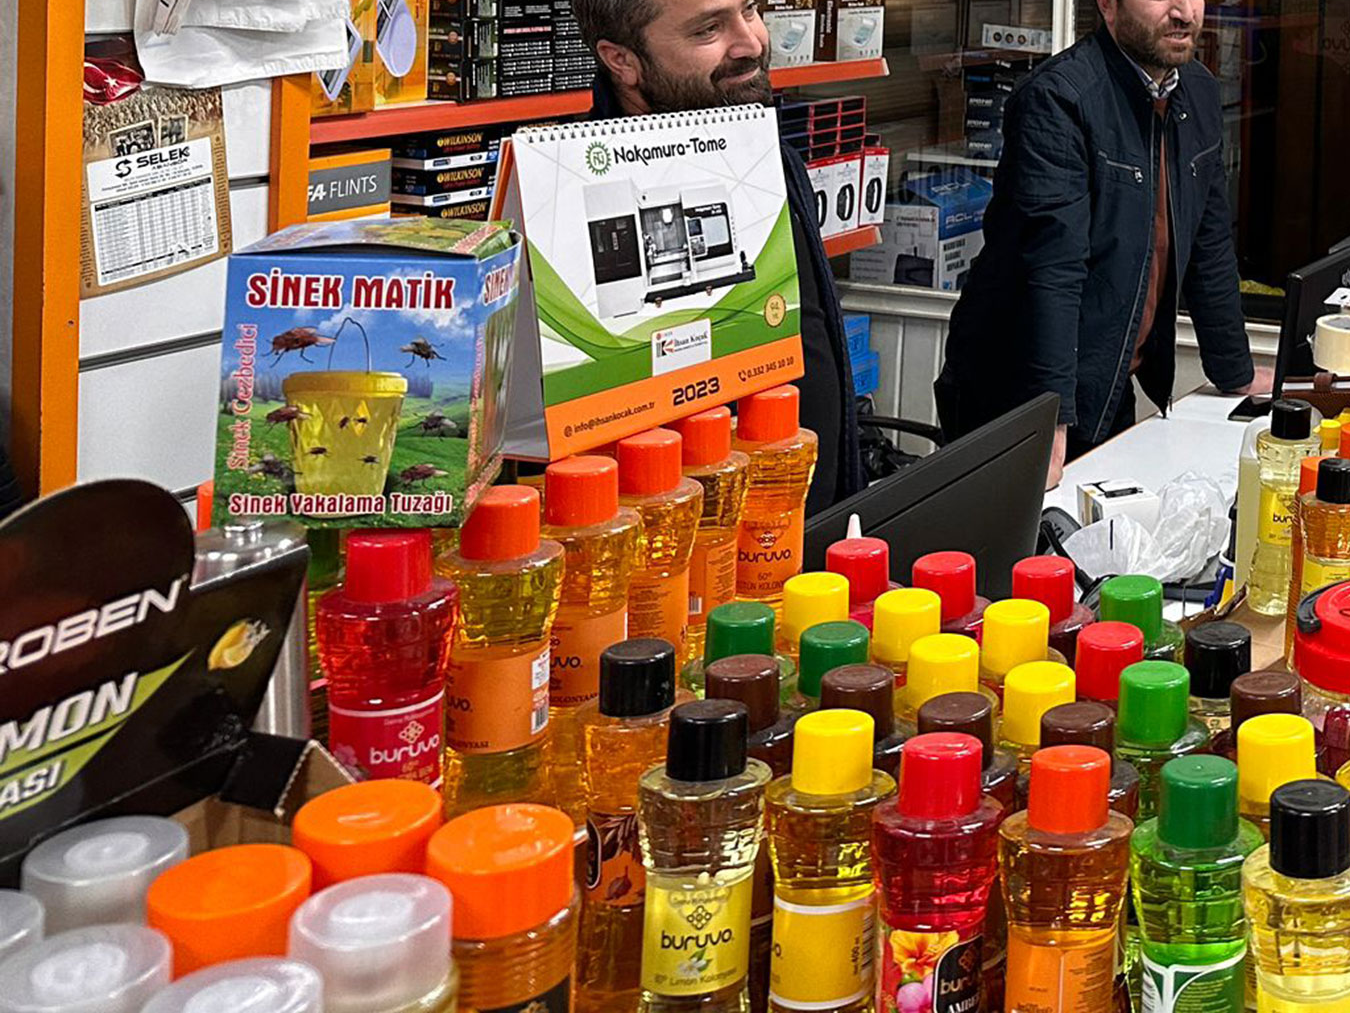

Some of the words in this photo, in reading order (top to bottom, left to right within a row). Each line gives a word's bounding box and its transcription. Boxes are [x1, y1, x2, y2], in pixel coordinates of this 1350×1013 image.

[137, 146, 190, 168] SELEK
[613, 137, 727, 166] Nakamura-Tome
[329, 175, 377, 199] FLINTS
[247, 268, 343, 308] SİNEK
[353, 271, 456, 310] MATİK
[672, 376, 721, 406] 2023
[291, 492, 385, 515] Yakalama
[391, 490, 453, 515] Tuzağı
[738, 548, 792, 563] buruvo
[661, 928, 733, 951] buruvo
